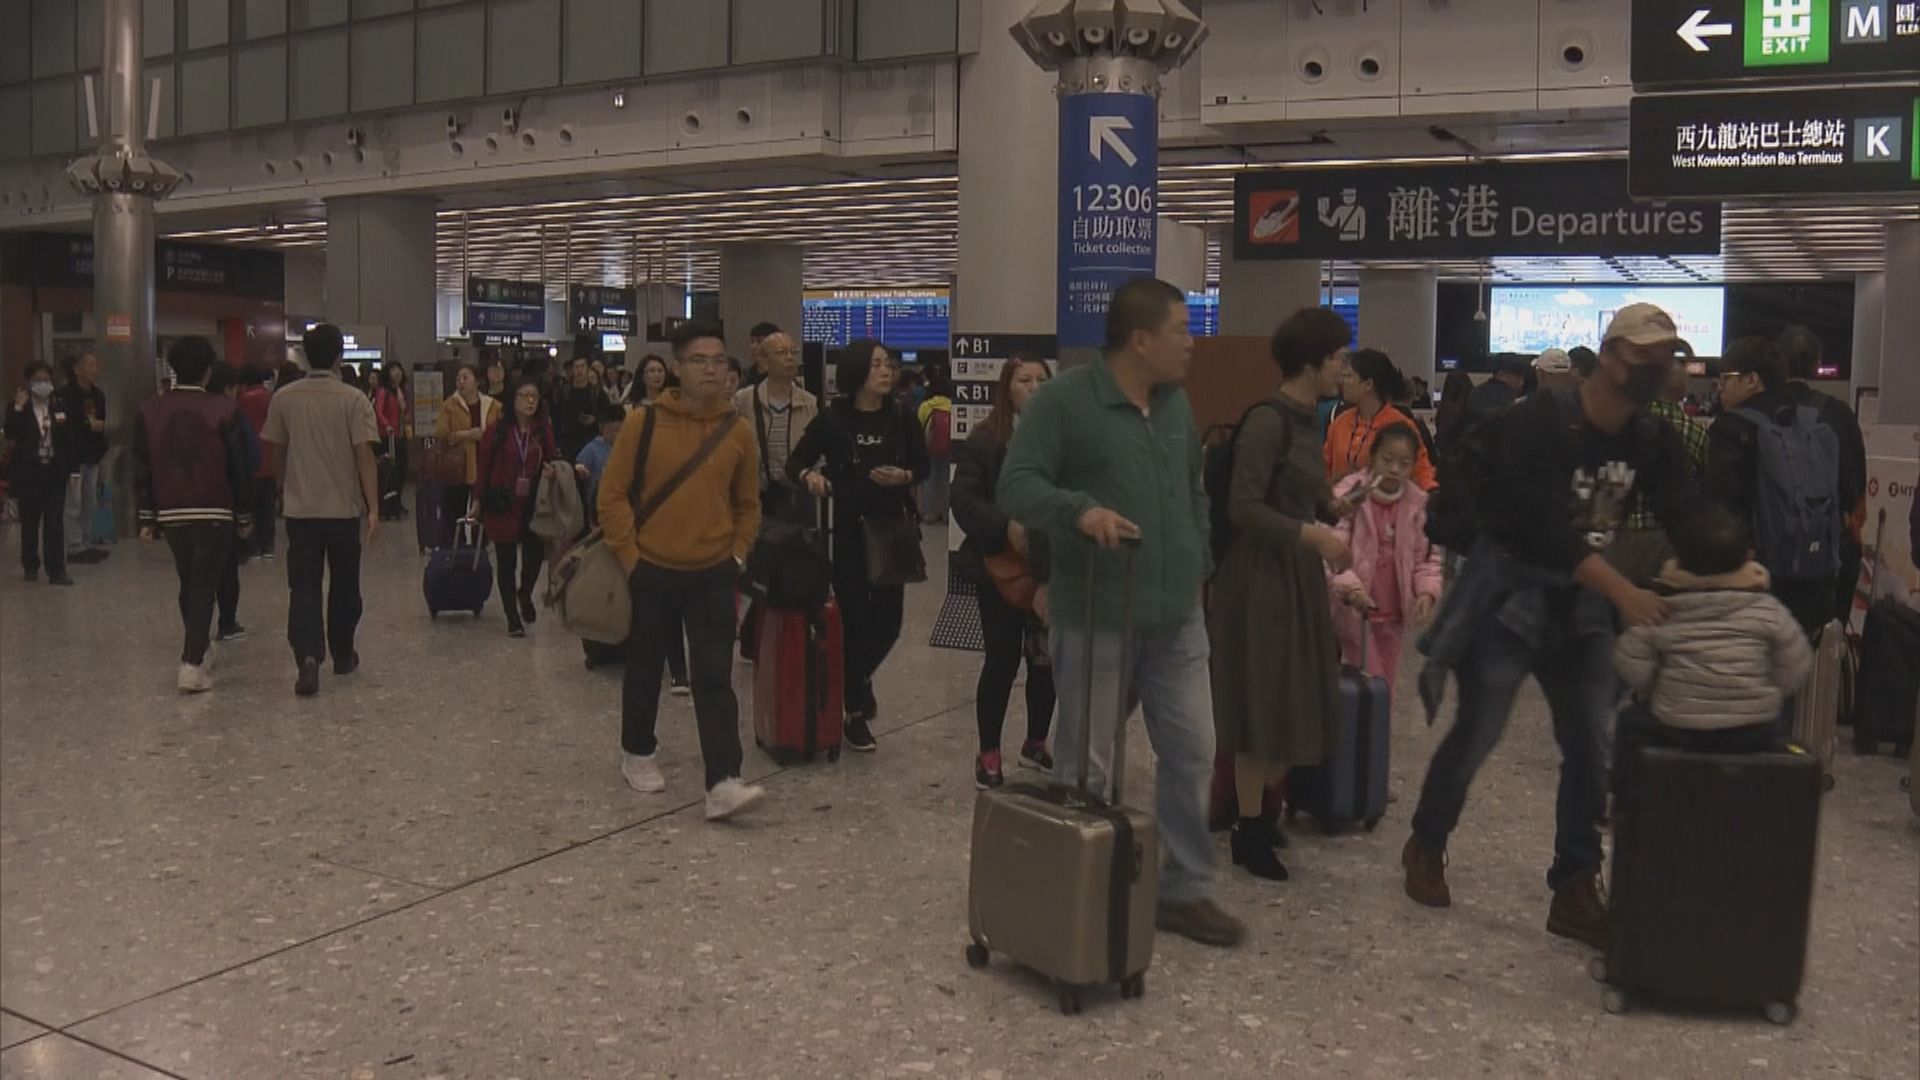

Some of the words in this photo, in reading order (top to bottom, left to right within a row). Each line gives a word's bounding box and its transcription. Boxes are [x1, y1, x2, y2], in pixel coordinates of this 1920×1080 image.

[1847, 5, 1881, 37] M
[1762, 37, 1810, 55] EXIT
[1676, 119, 1846, 151] 西九龍站巴士總站
[1866, 125, 1890, 157] K
[1672, 154, 1696, 168] West
[1697, 153, 1740, 168] Kowloon
[1741, 152, 1776, 167] Station
[1778, 151, 1796, 166] Bus
[1798, 150, 1843, 165] Terminus
[1073, 183, 1152, 214] 12306
[1387, 184, 1499, 241] 離港
[1511, 206, 1703, 243] Departures
[1073, 215, 1152, 240] 自助取票
[1073, 242, 1104, 254] Ticket
[1106, 242, 1152, 255] collection
[588, 316, 596, 331] P
[973, 338, 990, 353] B1
[972, 385, 989, 400] B1
